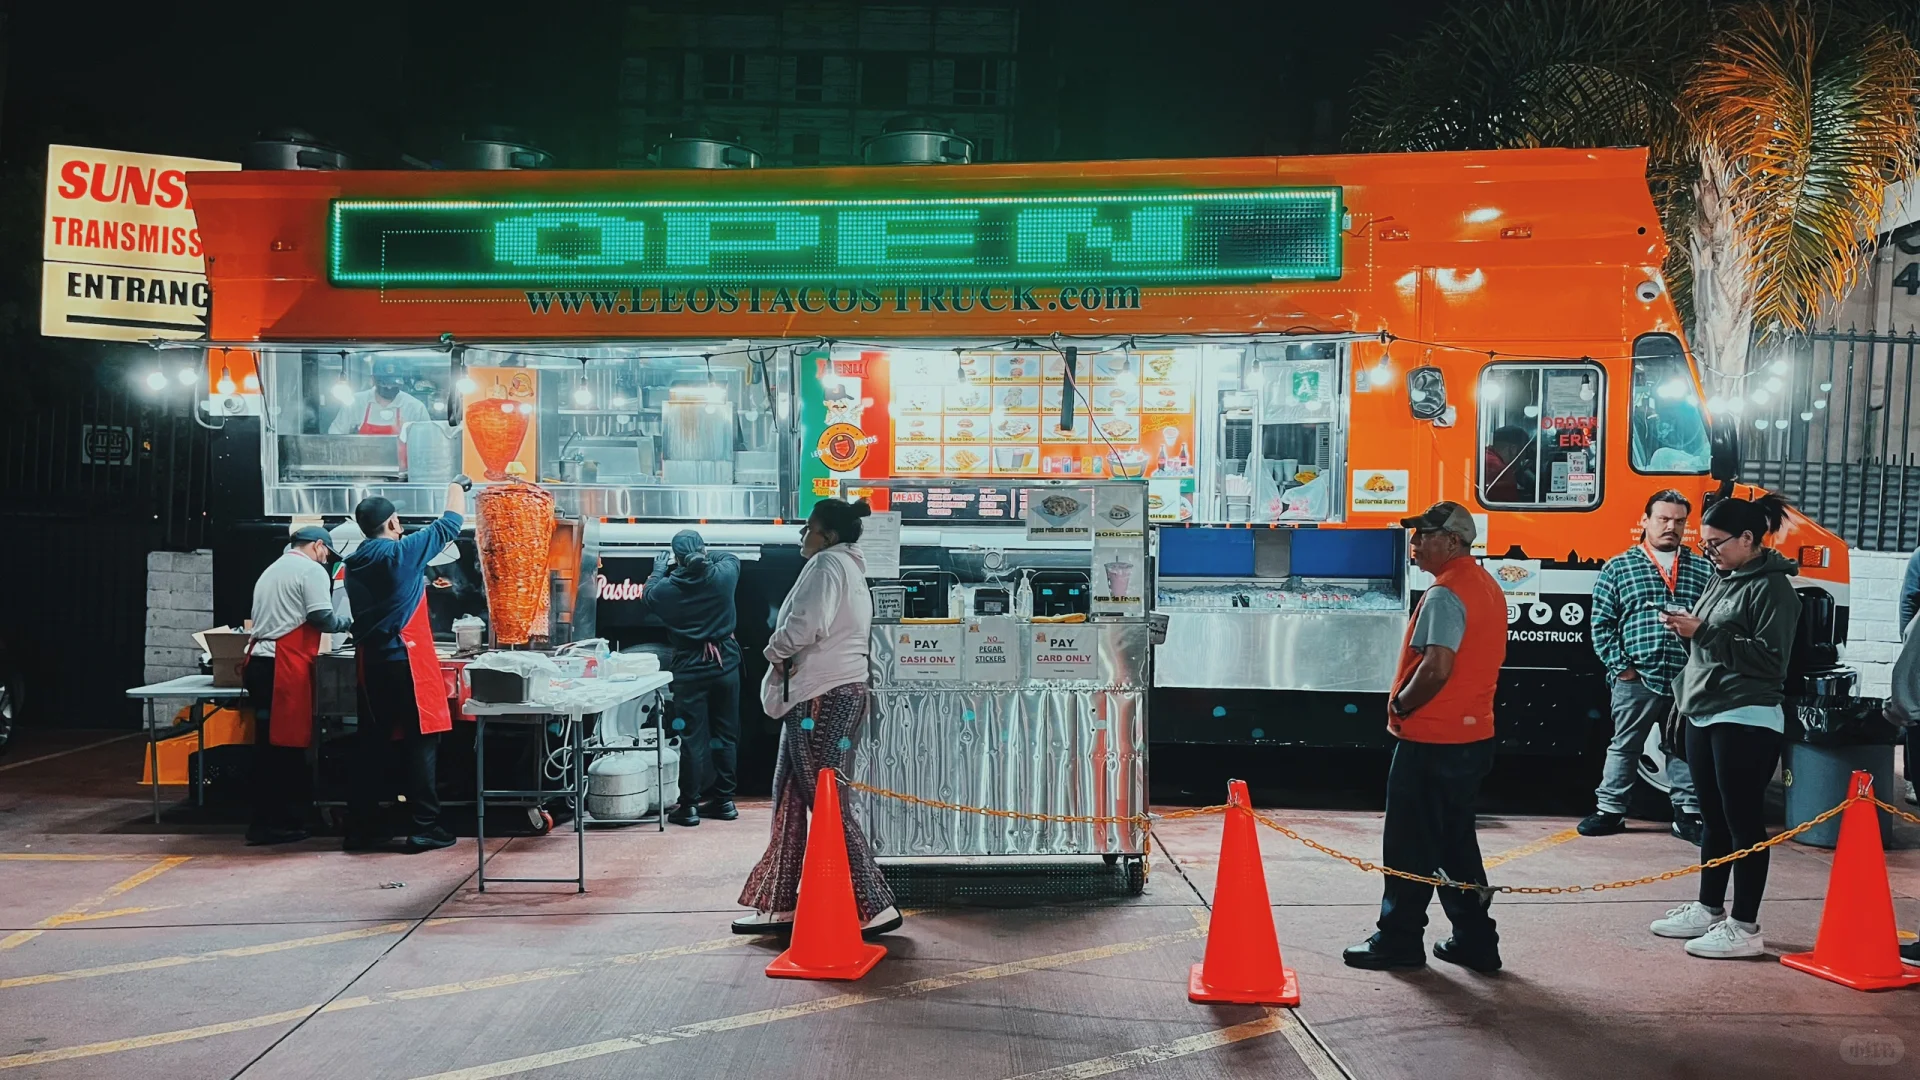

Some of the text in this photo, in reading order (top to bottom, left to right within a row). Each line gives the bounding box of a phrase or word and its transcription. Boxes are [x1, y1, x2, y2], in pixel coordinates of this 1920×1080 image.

[58, 160, 194, 210] SUNS
[494, 206, 1193, 266] OPEN
[525, 284, 1141, 315] www.LEOSTACOSTRUCK.com
[1541, 417, 1598, 430] ORDER
[814, 479, 839, 488] THE
[893, 493, 924, 502] MEATS
[1507, 630, 1583, 643] TACOSTRUCK
[914, 640, 938, 649] PAY
[1051, 639, 1075, 648] PAY
